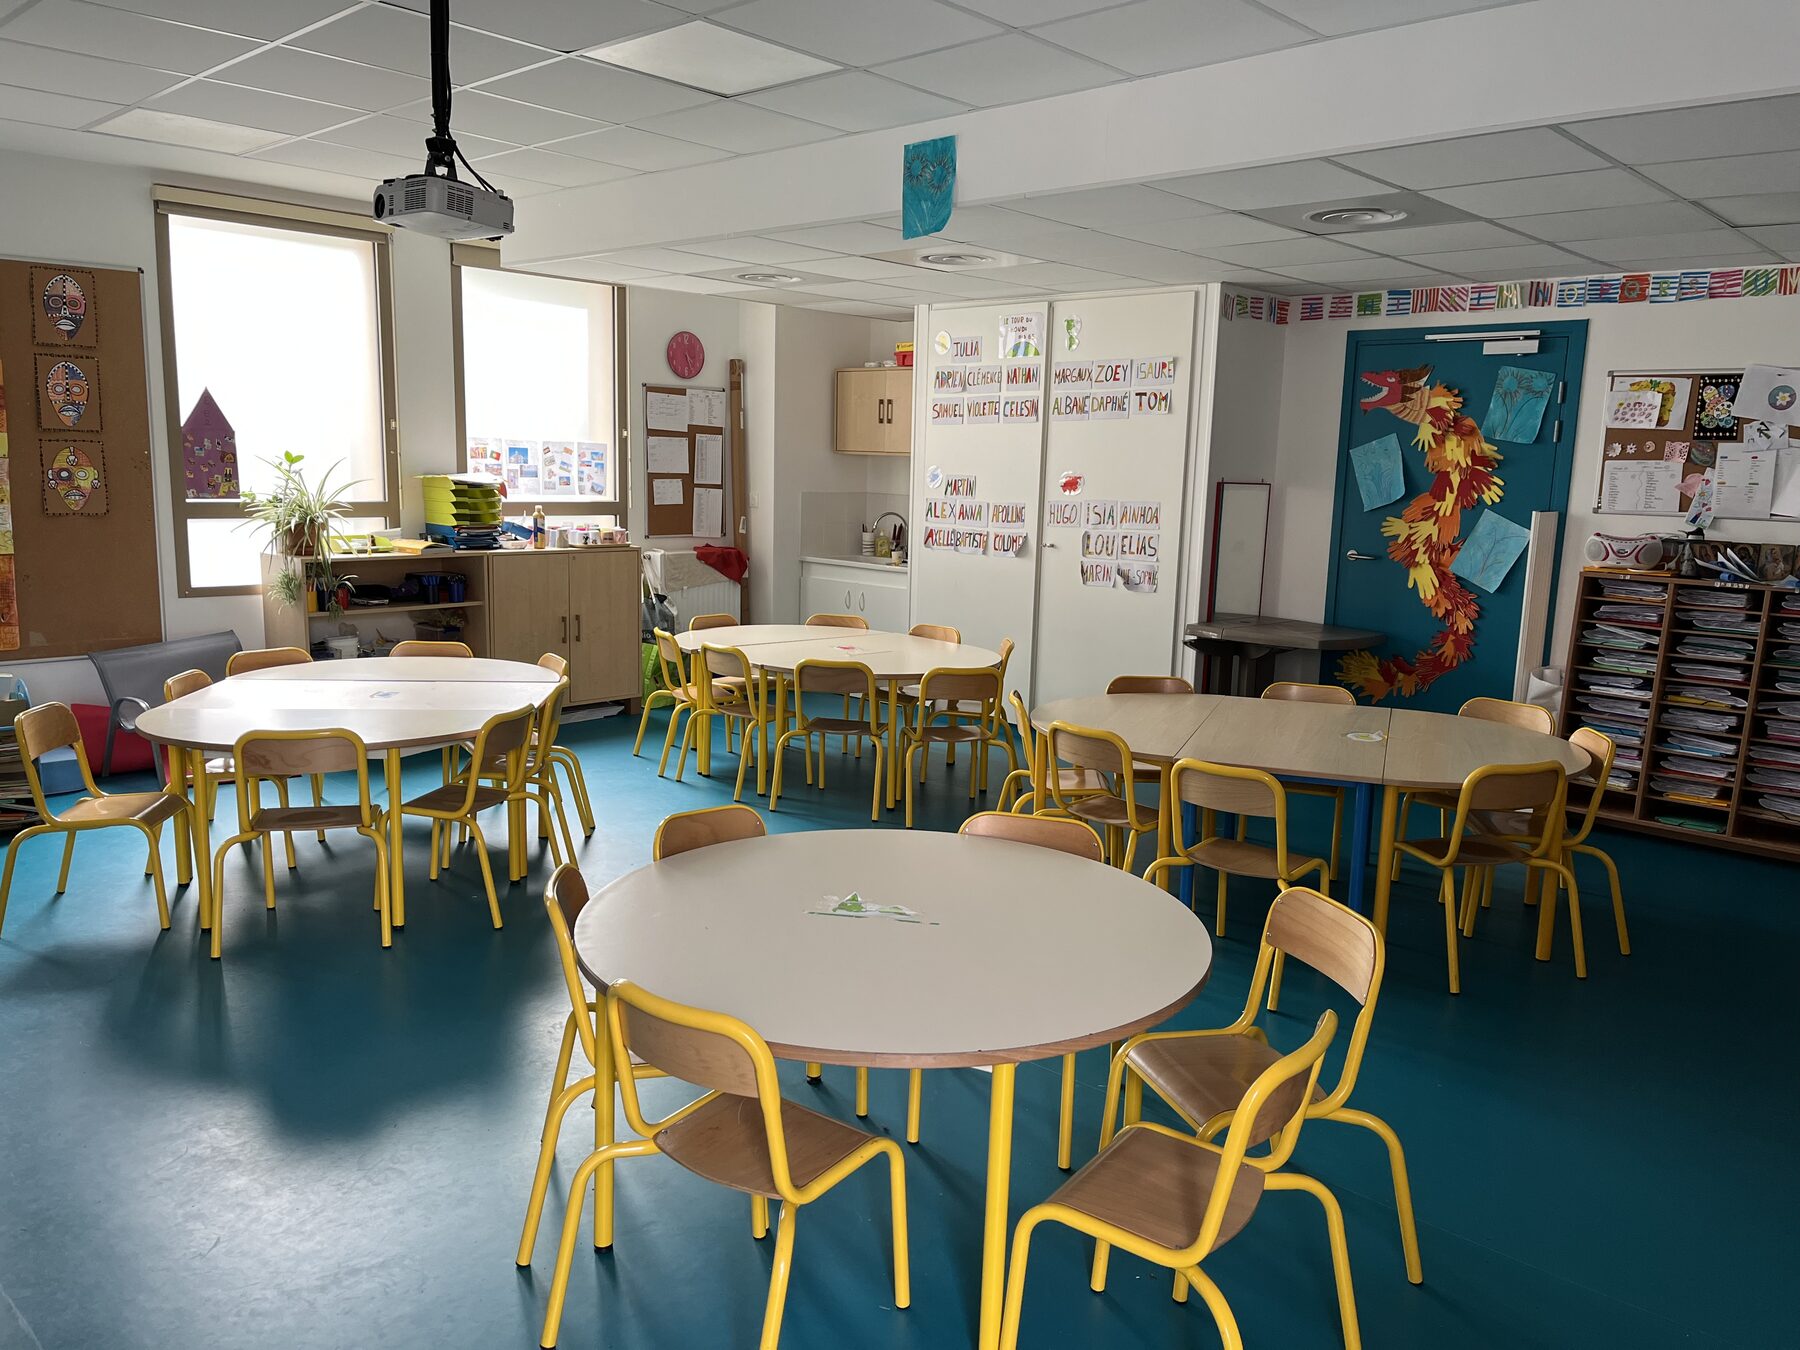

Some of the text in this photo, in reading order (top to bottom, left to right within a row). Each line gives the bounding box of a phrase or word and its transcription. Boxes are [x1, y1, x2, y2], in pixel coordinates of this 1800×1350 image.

[1564, 285, 1578, 303] O
[1006, 367, 1039, 385] NATHAN
[1054, 367, 1093, 385] MARGAUX
[1094, 364, 1129, 383] ZOEY
[1052, 395, 1091, 415] ALBANE
[1091, 392, 1128, 412] DAPHNÉ
[1135, 391, 1169, 411] TOM
[932, 403, 964, 419] SAMUEL
[926, 502, 956, 518] ALEX
[958, 504, 983, 521] ANNA
[1049, 504, 1078, 524] HUGO
[1120, 505, 1159, 524] AINHOA
[924, 528, 954, 546] AXELLE
[955, 531, 988, 550] BAPTISTE
[993, 533, 1024, 551] COLOMB
[1085, 534, 1115, 556] LOU
